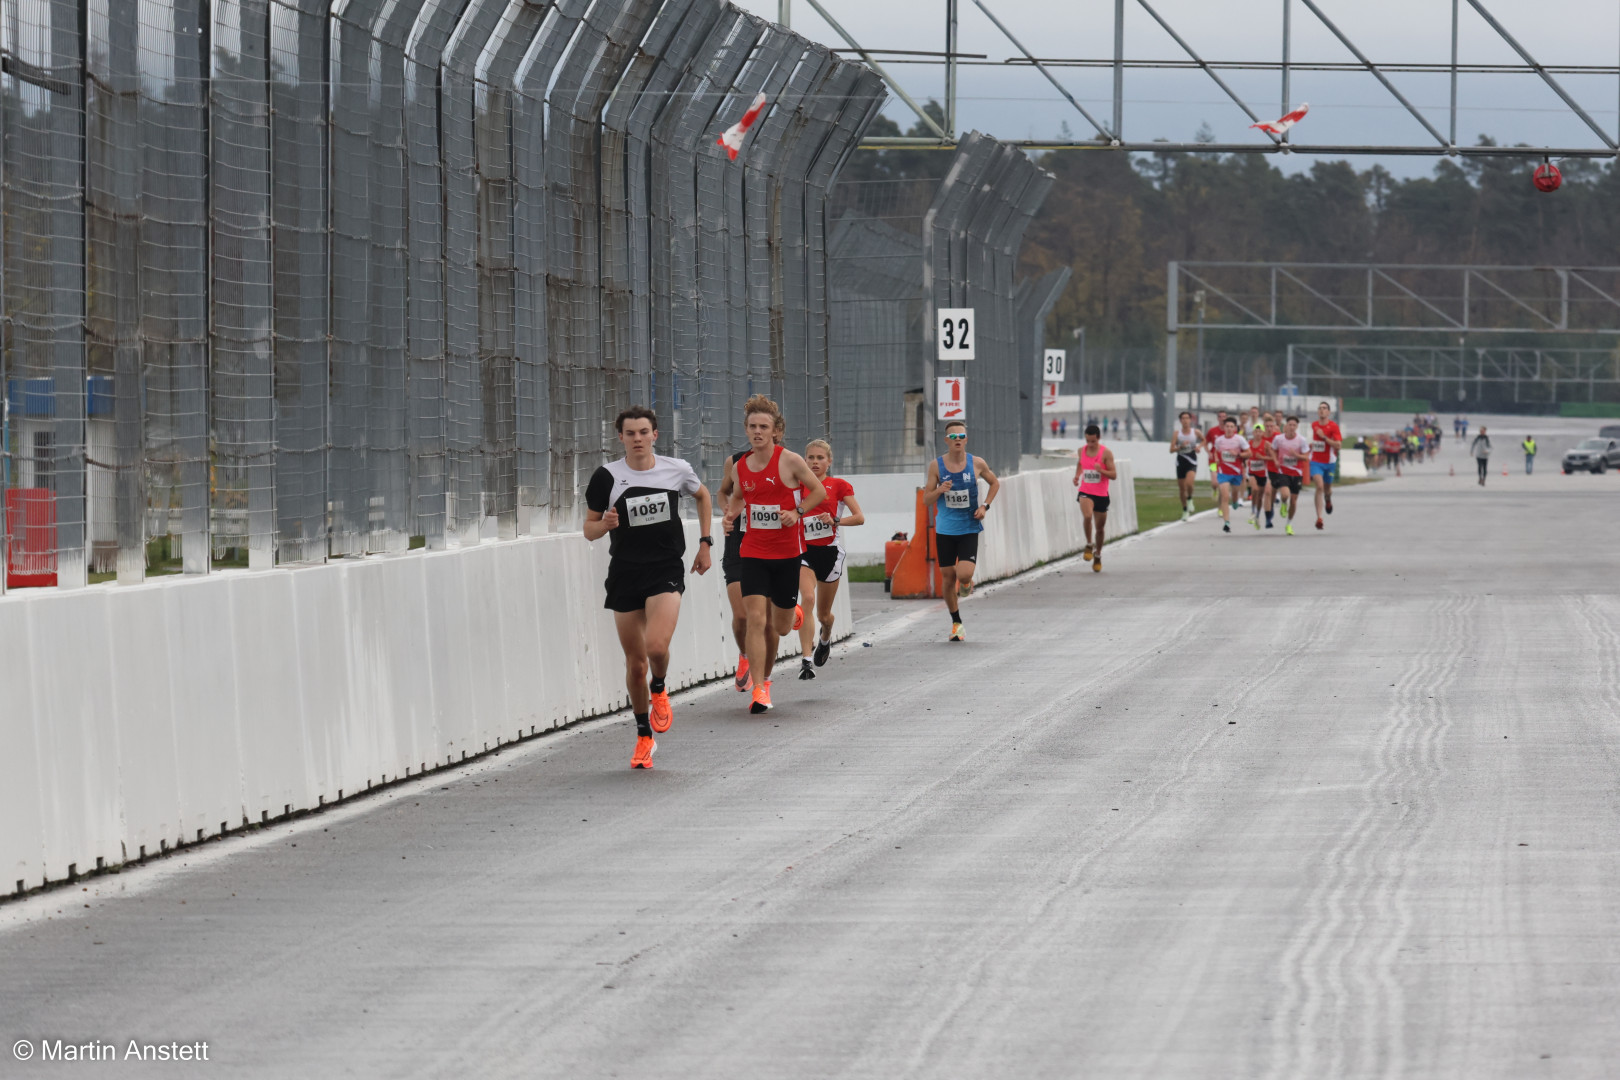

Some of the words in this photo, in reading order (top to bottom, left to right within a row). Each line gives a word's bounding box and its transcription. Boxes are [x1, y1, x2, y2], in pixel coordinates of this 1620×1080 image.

[942, 318, 970, 350] 32
[1046, 355, 1062, 375] 30
[945, 494, 968, 503] 1182
[630, 501, 666, 517] 1087
[751, 511, 779, 522] 1090
[804, 521, 830, 534] 1105
